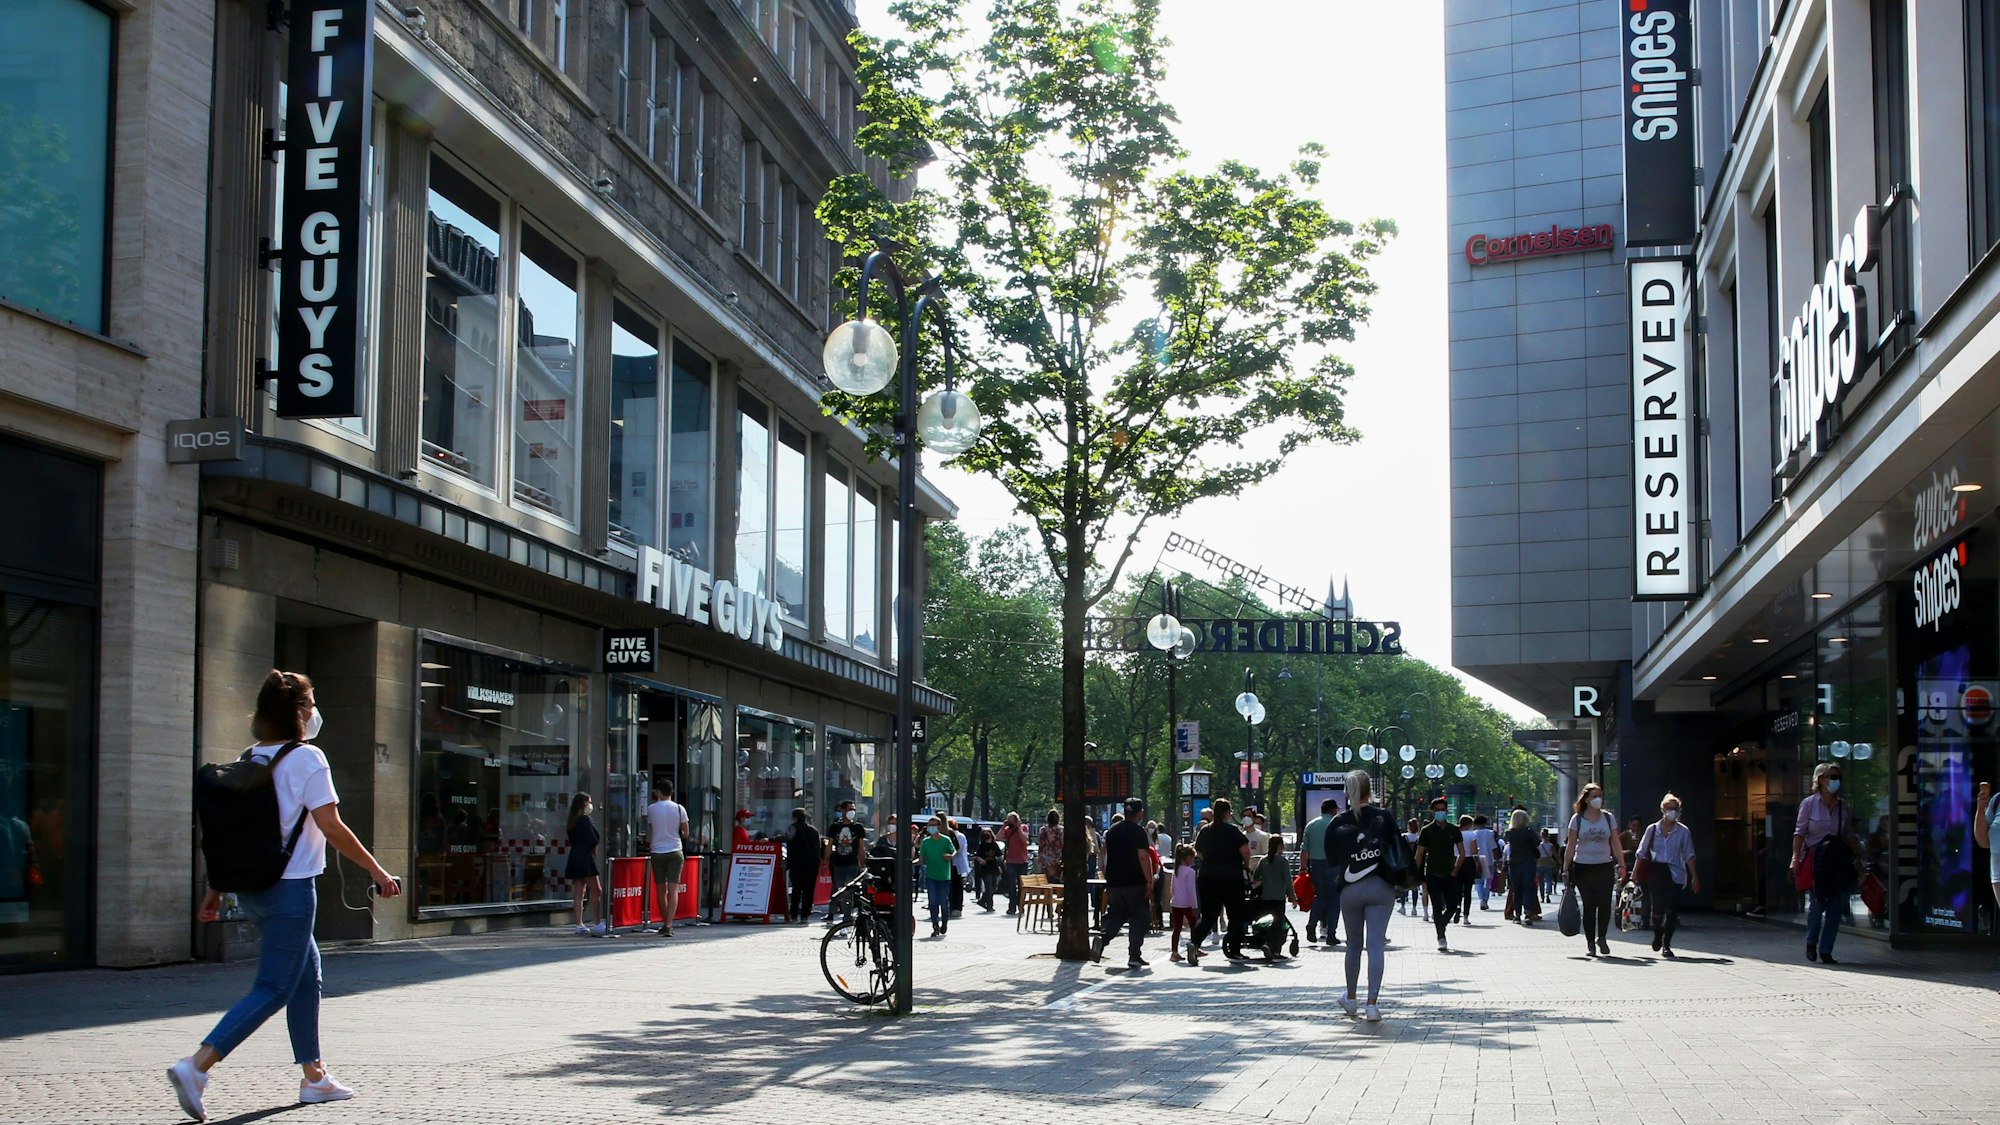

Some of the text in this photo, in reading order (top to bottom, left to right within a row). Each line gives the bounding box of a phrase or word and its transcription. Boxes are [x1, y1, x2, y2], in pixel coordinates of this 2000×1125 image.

[1629, 10, 1687, 141] snipes
[297, 9, 343, 397] FIVE GUYS
[1465, 223, 1613, 265] Cornelsen
[1778, 233, 1862, 460] snipes
[174, 431, 230, 449] IQOS
[1642, 278, 1680, 576] RESERVED
[637, 545, 783, 652] FIVE GUYS
[1913, 547, 1960, 632] snipes
[605, 650, 652, 664] GUYS
[610, 637, 647, 650] FIVE
[467, 685, 514, 706] MILKSHAKES
[1573, 685, 1602, 717] R
[1303, 773, 1346, 784] U Neumark
[613, 886, 642, 898] FIVE GUYS
